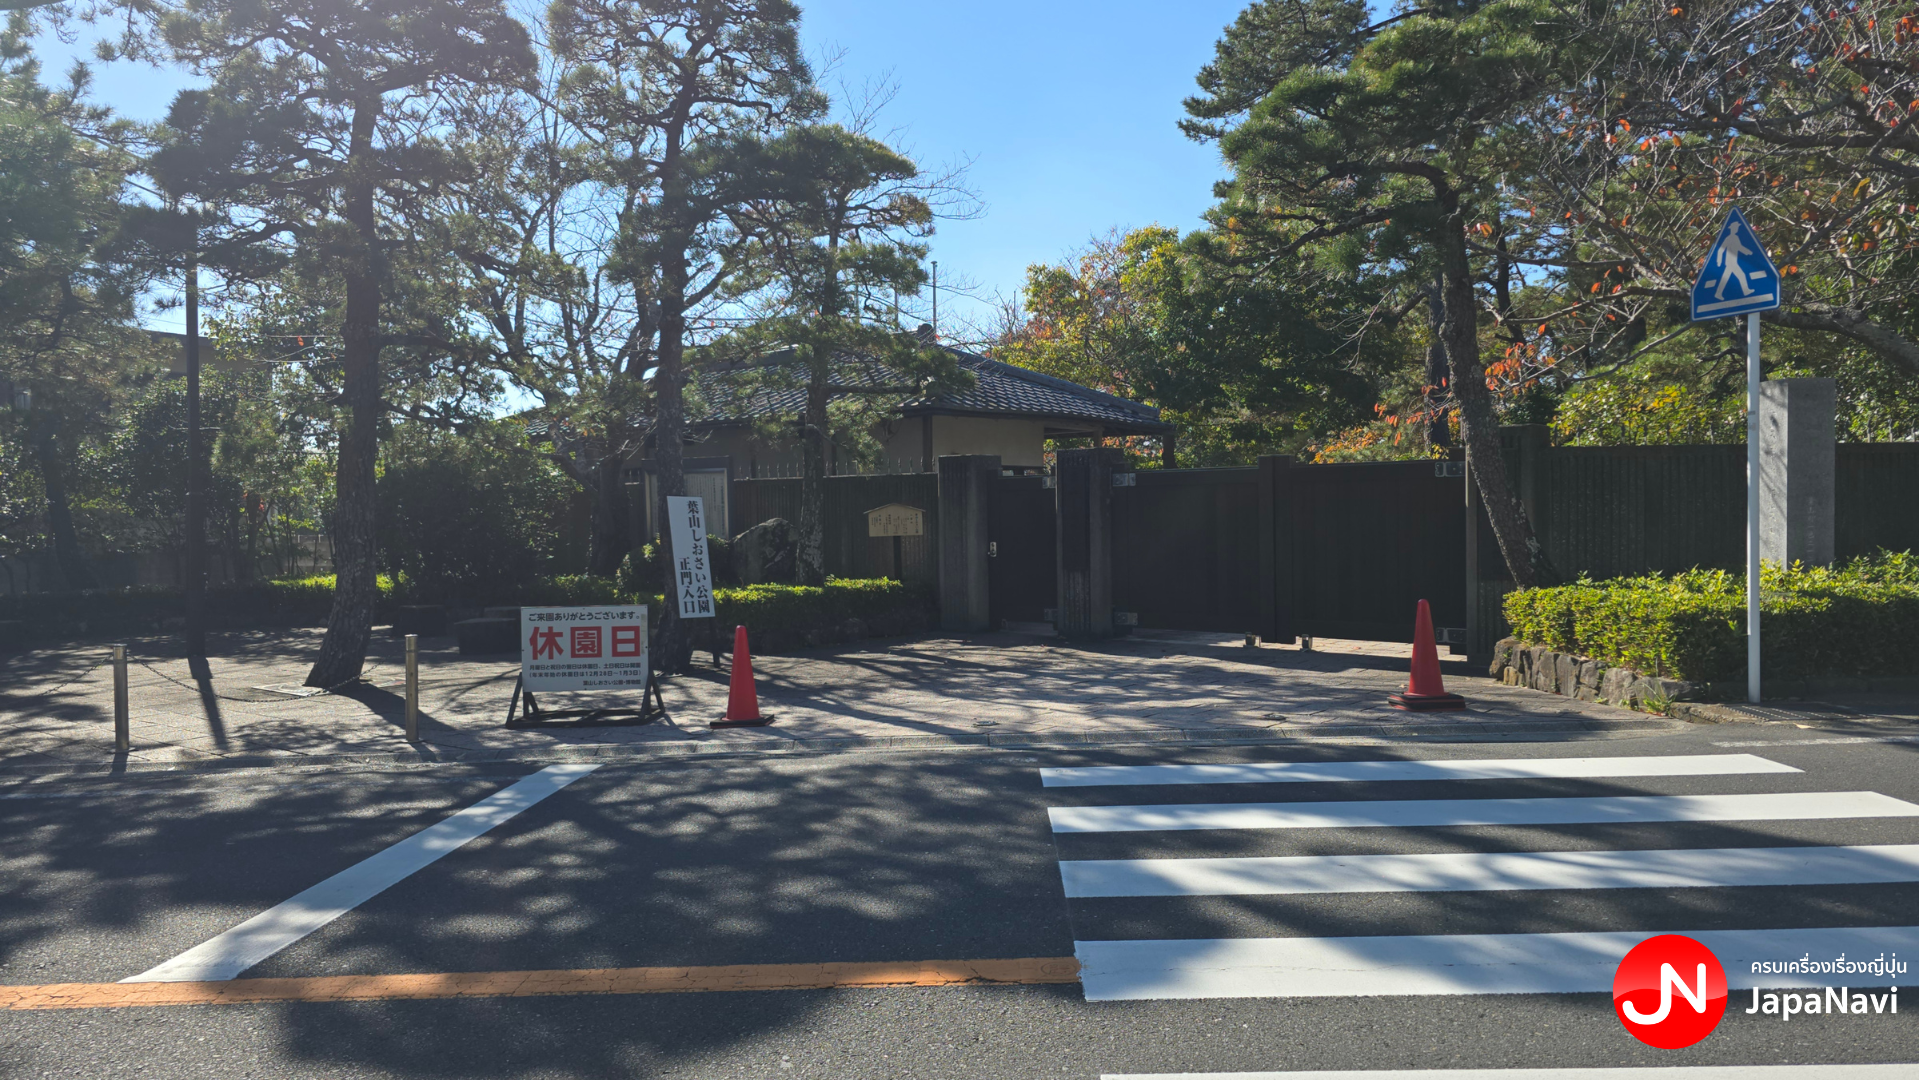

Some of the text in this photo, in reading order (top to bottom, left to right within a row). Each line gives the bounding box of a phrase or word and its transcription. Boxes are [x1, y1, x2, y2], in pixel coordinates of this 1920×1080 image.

[687, 500, 711, 614] 葉山しおさい公園
[679, 556, 696, 614] 正門入口
[528, 611, 640, 621] ご来園ありがとうございます。
[529, 626, 641, 660] 休園日
